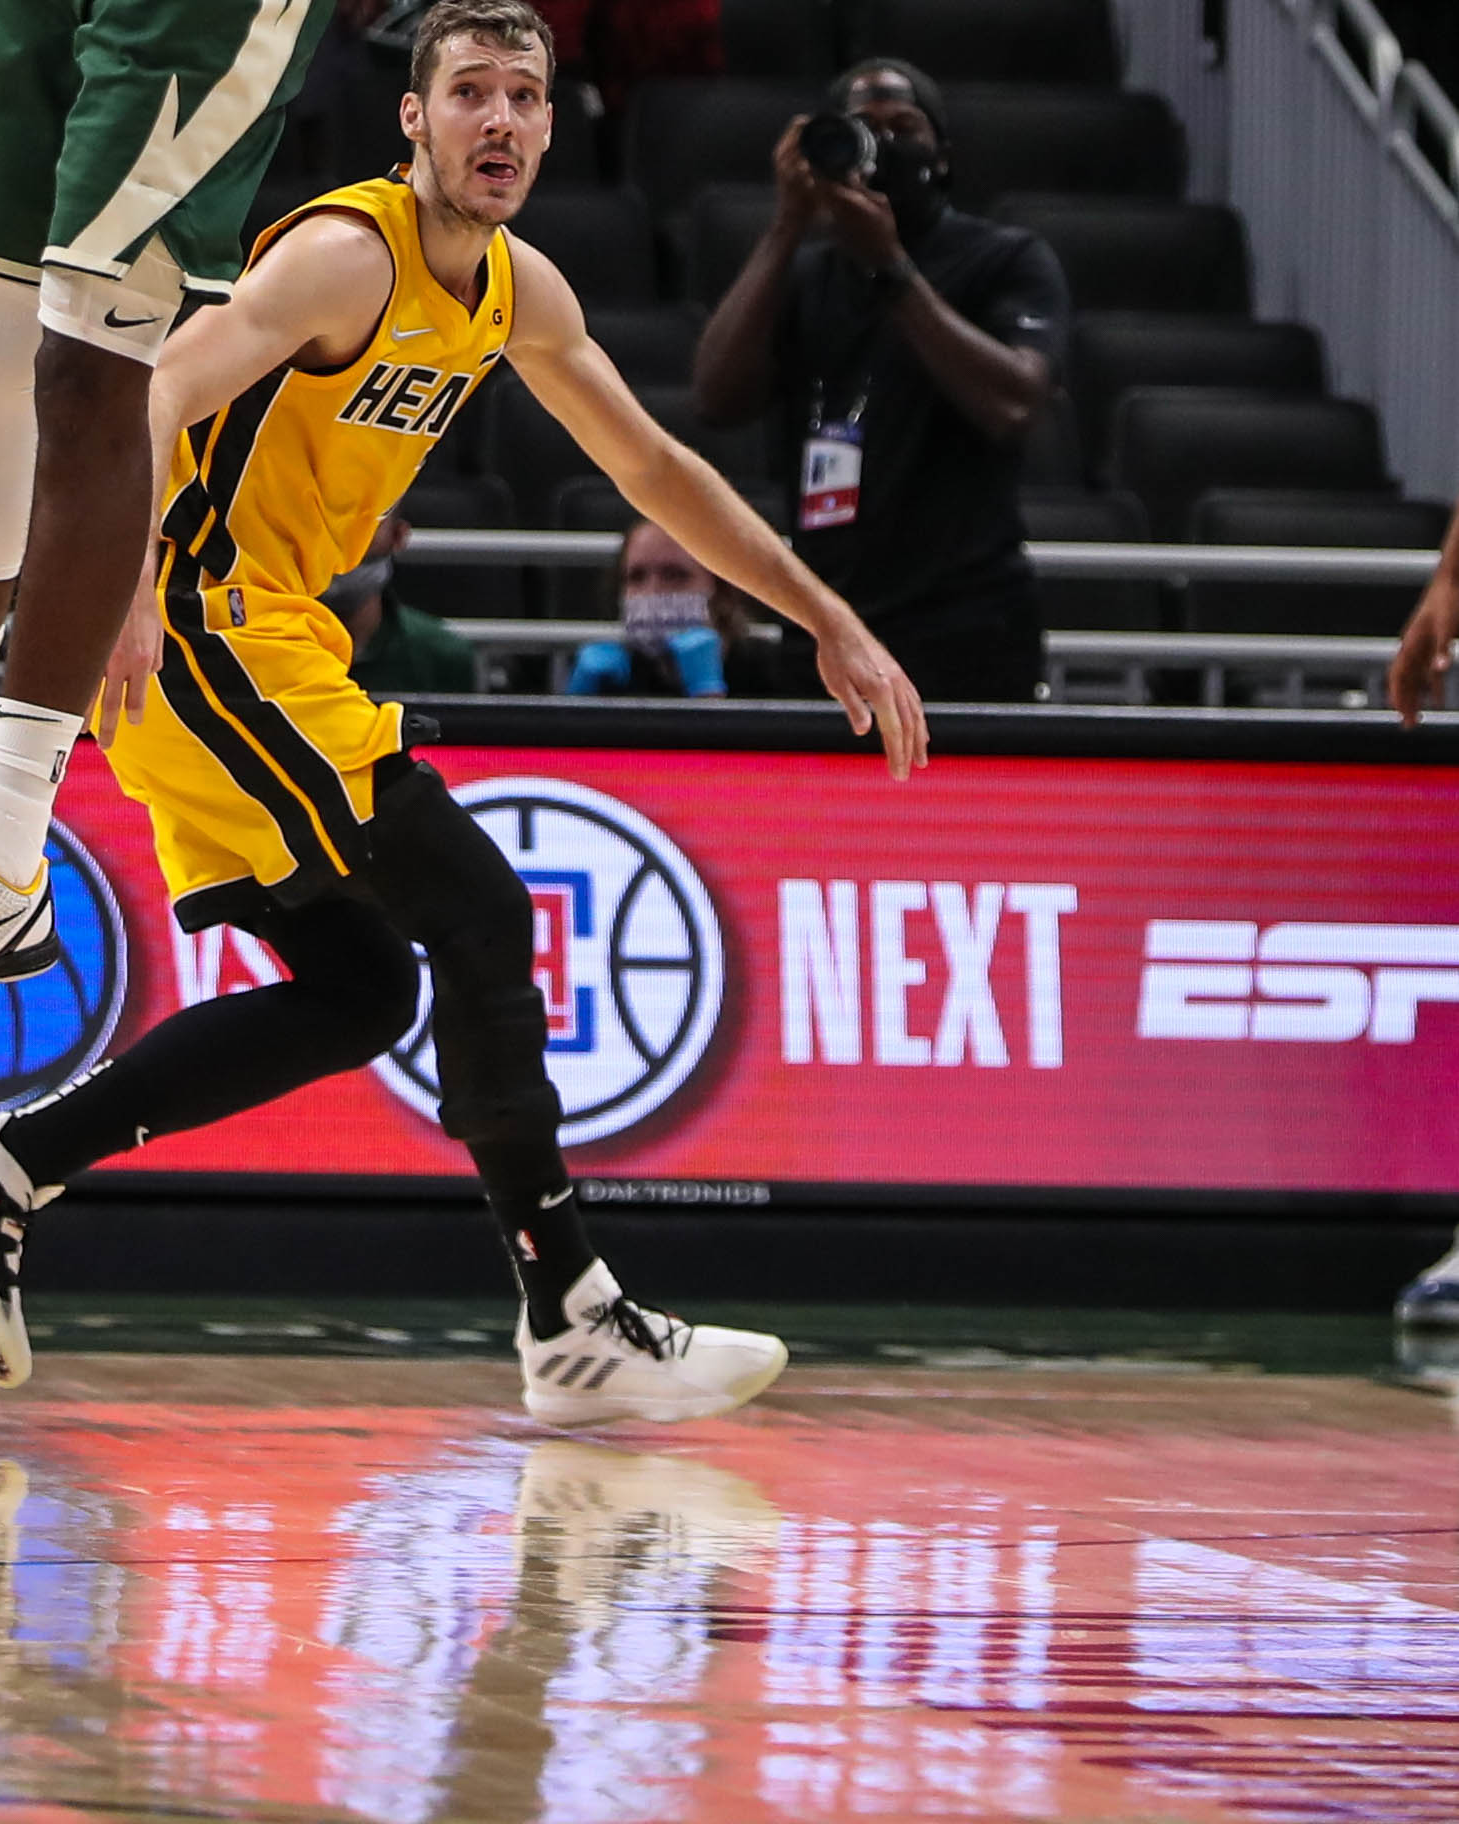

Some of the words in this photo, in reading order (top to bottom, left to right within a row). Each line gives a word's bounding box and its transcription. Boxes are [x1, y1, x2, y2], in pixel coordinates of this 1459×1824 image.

[334, 356, 479, 439] HEA
[778, 877, 1078, 1069] NEXT
[579, 1180, 772, 1206] DAKTRONICS
